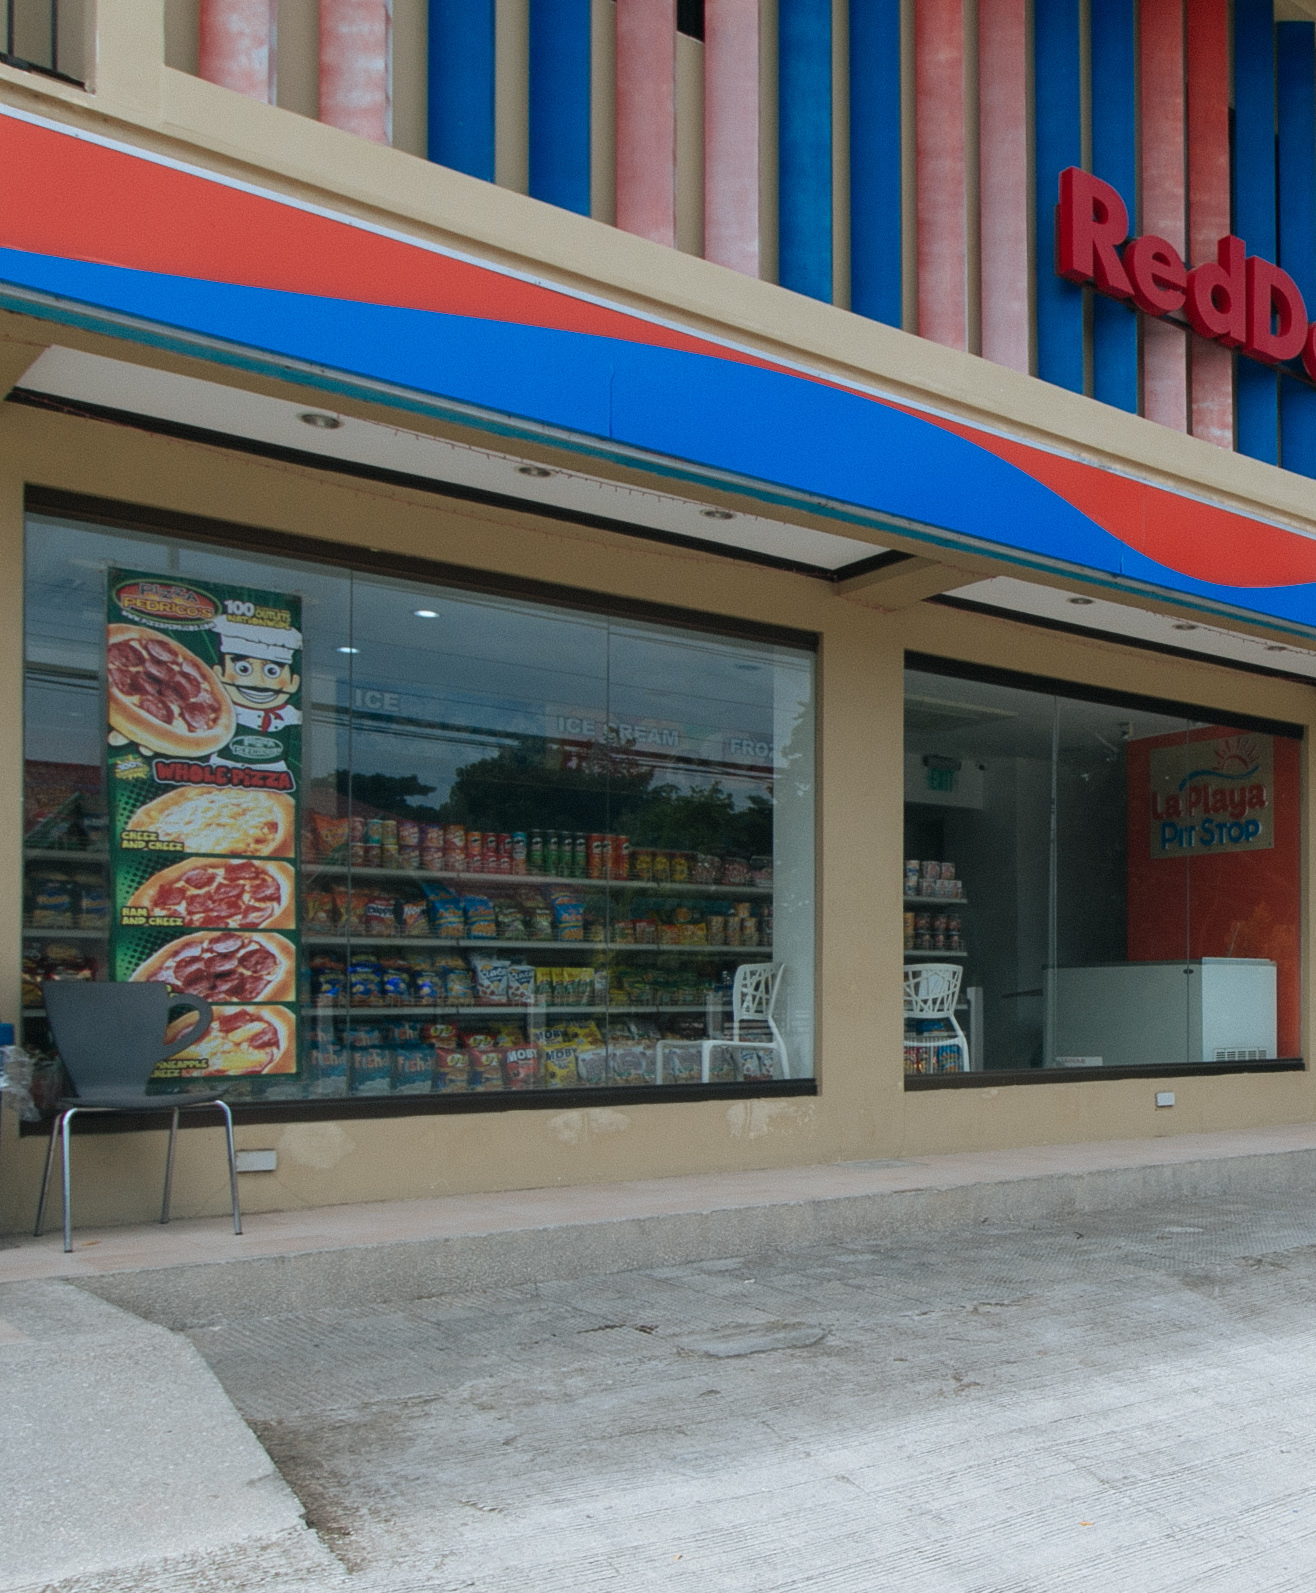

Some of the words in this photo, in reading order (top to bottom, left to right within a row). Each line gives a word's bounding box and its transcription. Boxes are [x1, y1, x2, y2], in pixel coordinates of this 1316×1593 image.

[224, 599, 255, 617] 100
[355, 689, 400, 711] ICE
[558, 716, 595, 736] ICE
[604, 721, 680, 748] CREAM
[155, 761, 229, 785] WHOLE
[1152, 791, 1182, 819] La
[1188, 783, 1268, 819] Playa
[1200, 817, 1262, 846] STOP
[121, 840, 147, 850] AND
[121, 907, 148, 917] HAM
[121, 916, 147, 926] AND
[155, 1059, 208, 1069] INEAPPLE
